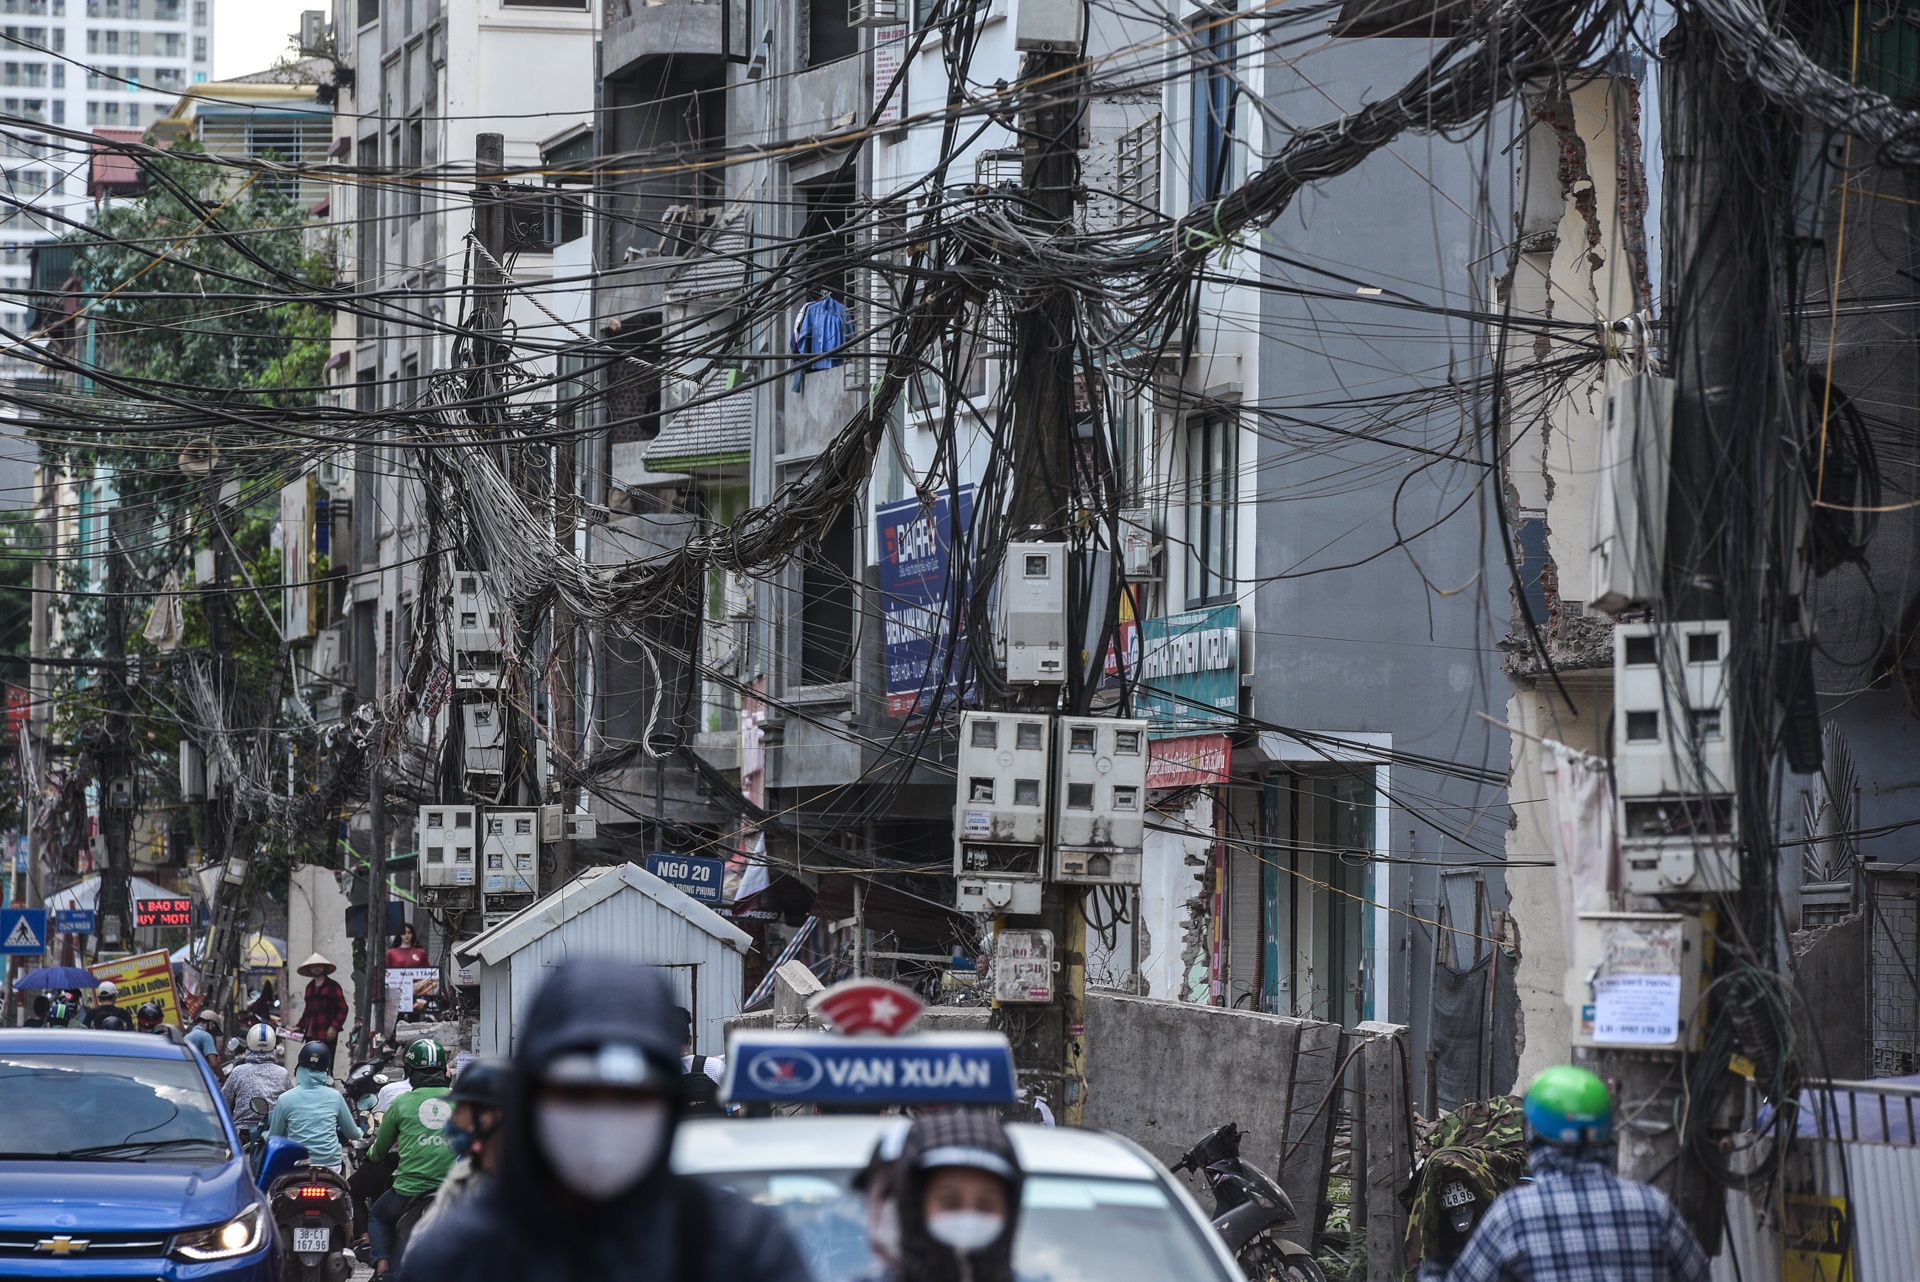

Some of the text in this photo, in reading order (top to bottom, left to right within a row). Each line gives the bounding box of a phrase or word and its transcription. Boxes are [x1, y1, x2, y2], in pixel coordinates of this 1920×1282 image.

[1200, 628, 1229, 672] WORLD
[657, 860, 710, 881] NGÕ 20
[695, 886, 716, 898] PHỤNG
[122, 962, 135, 973] HUY
[132, 981, 146, 995] BẢO
[825, 1051, 991, 1093] VẠN XUÂN
[299, 1229, 324, 1240] 38-C1
[296, 1240, 327, 1251] 167.96
